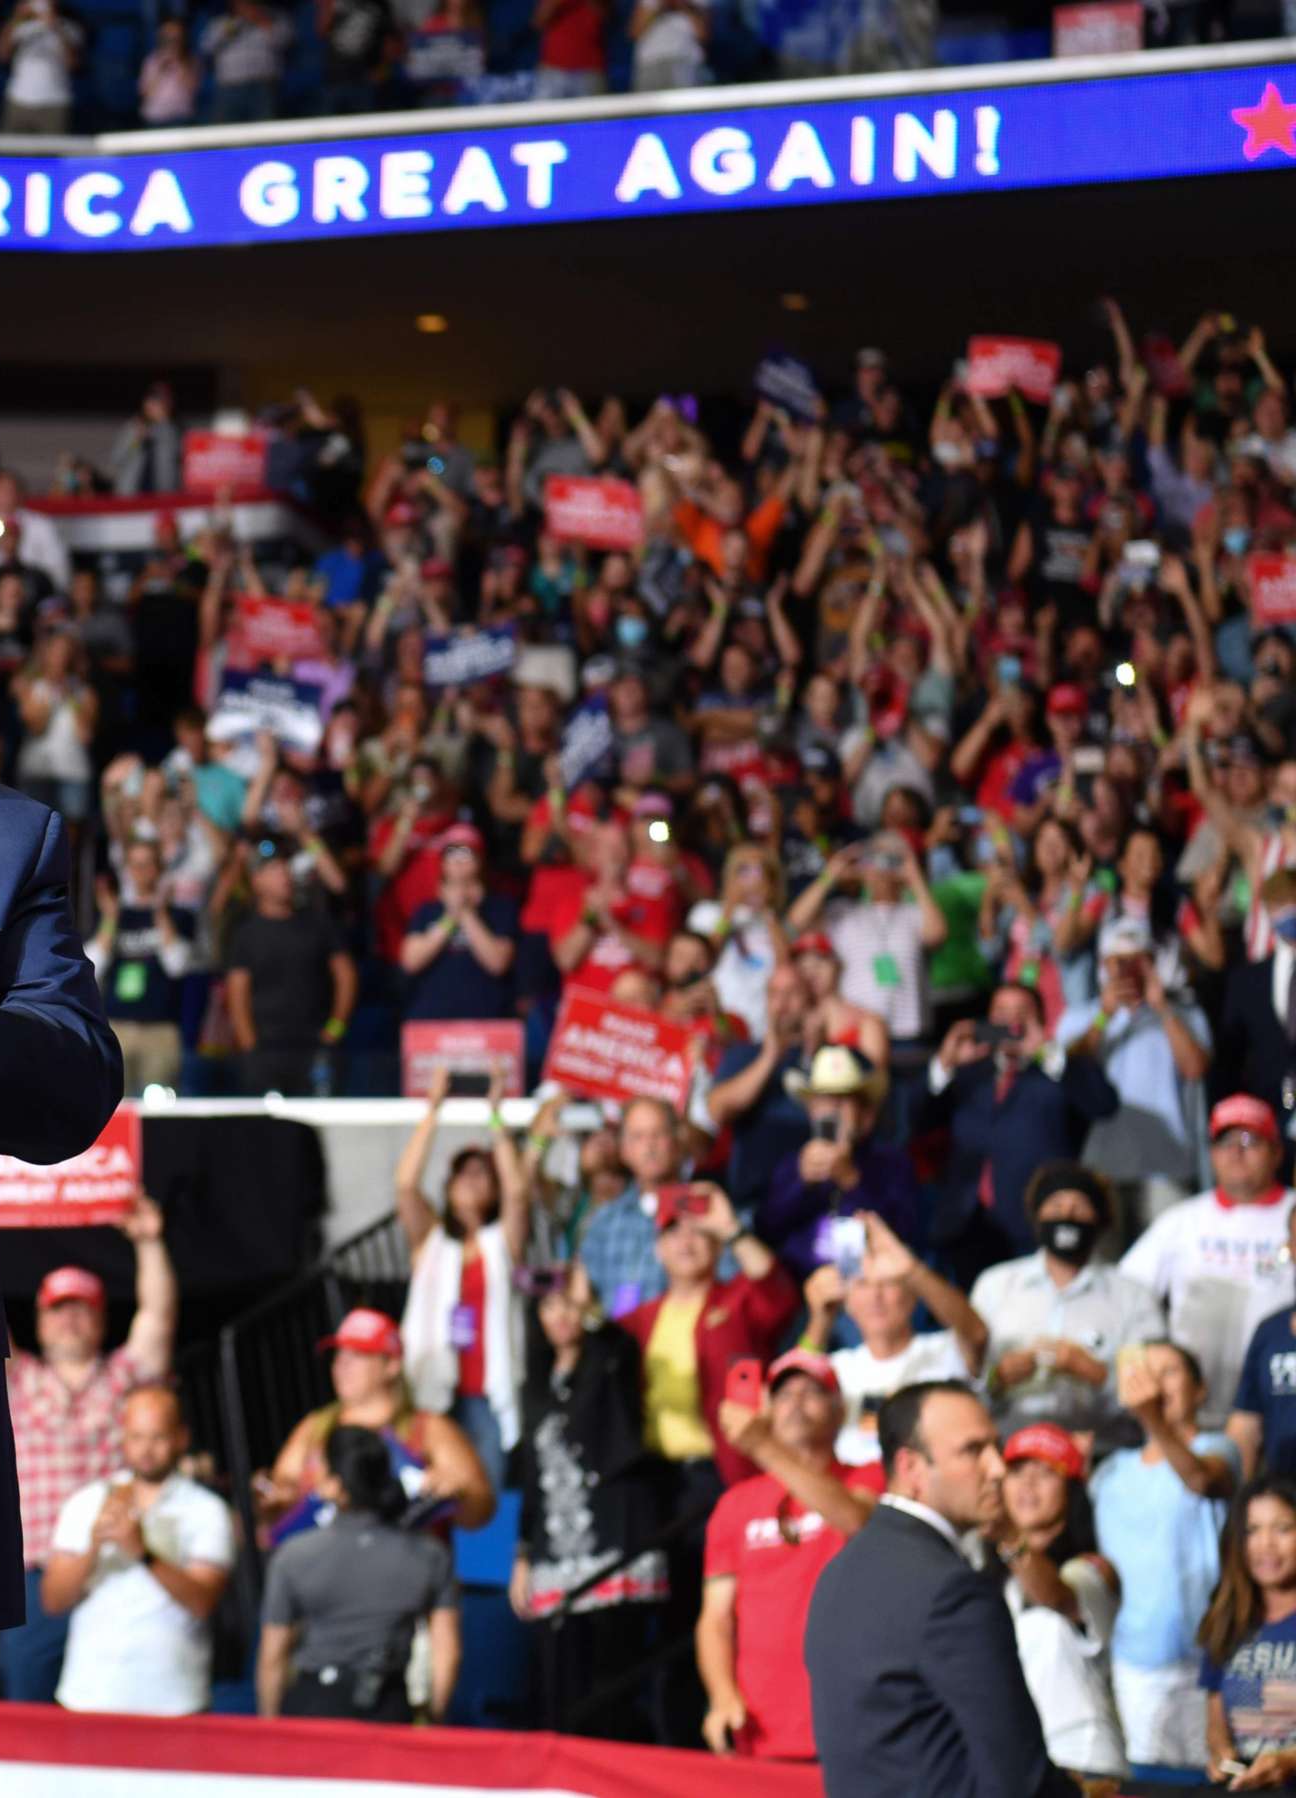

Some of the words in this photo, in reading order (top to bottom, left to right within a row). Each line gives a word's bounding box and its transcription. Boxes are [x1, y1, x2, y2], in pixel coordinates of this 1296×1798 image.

[239, 140, 567, 227] GREAT
[614, 106, 1000, 202] AGAIN!
[562, 1023, 685, 1079] AMERICA
